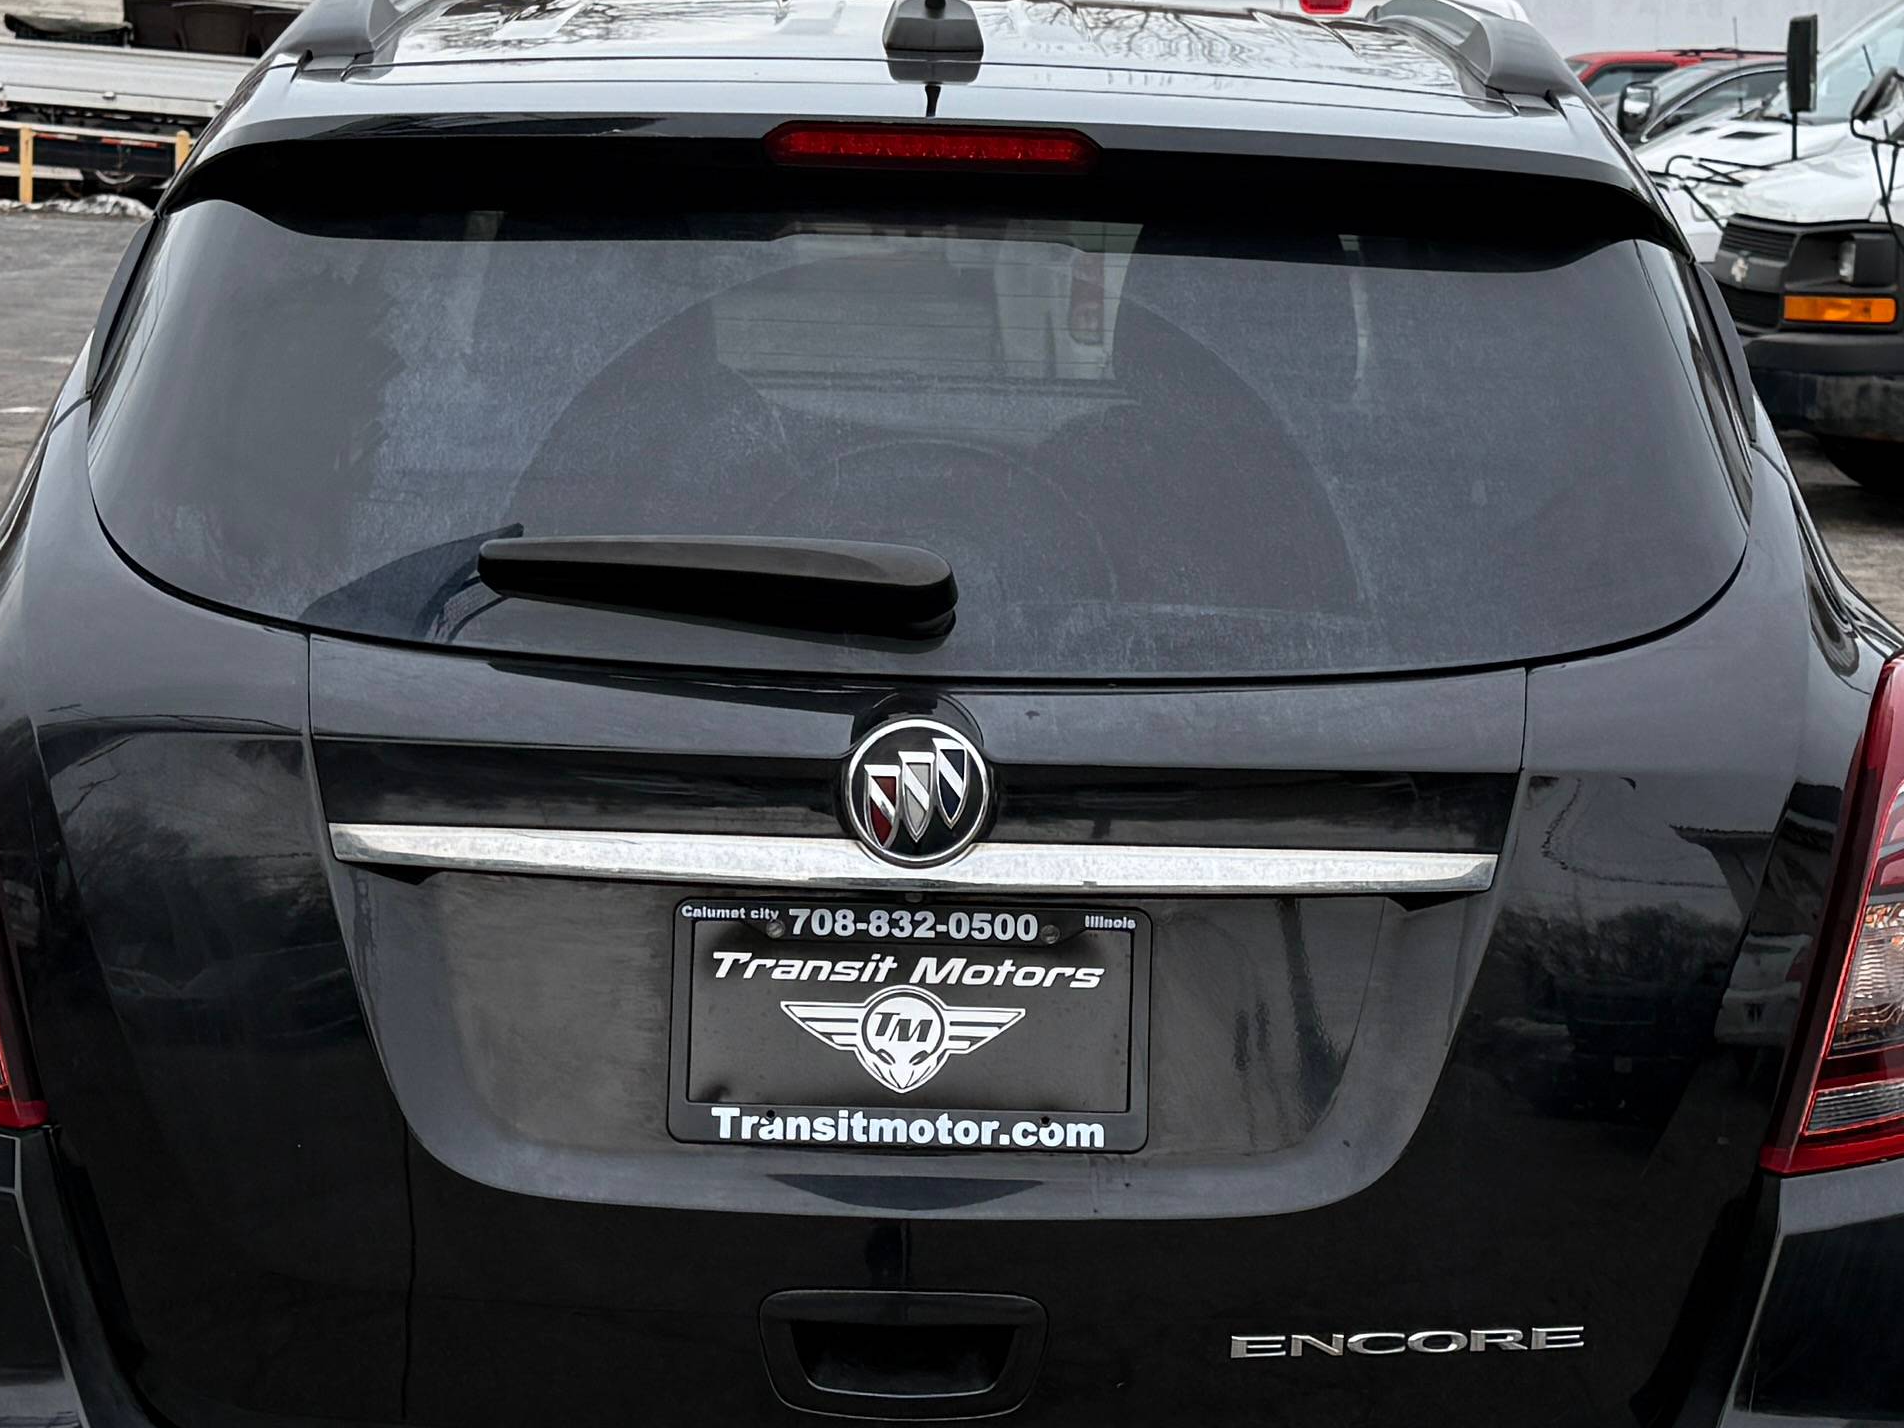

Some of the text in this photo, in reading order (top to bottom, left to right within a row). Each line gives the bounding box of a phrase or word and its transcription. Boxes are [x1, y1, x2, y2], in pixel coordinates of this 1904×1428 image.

[681, 904, 1137, 942] Calumet city 708-832-0500 Illinois
[712, 951, 1106, 989] Transit Motors
[711, 1107, 1105, 1149] Transitmotor.com
[1230, 1326, 1585, 1359] ENCORE
